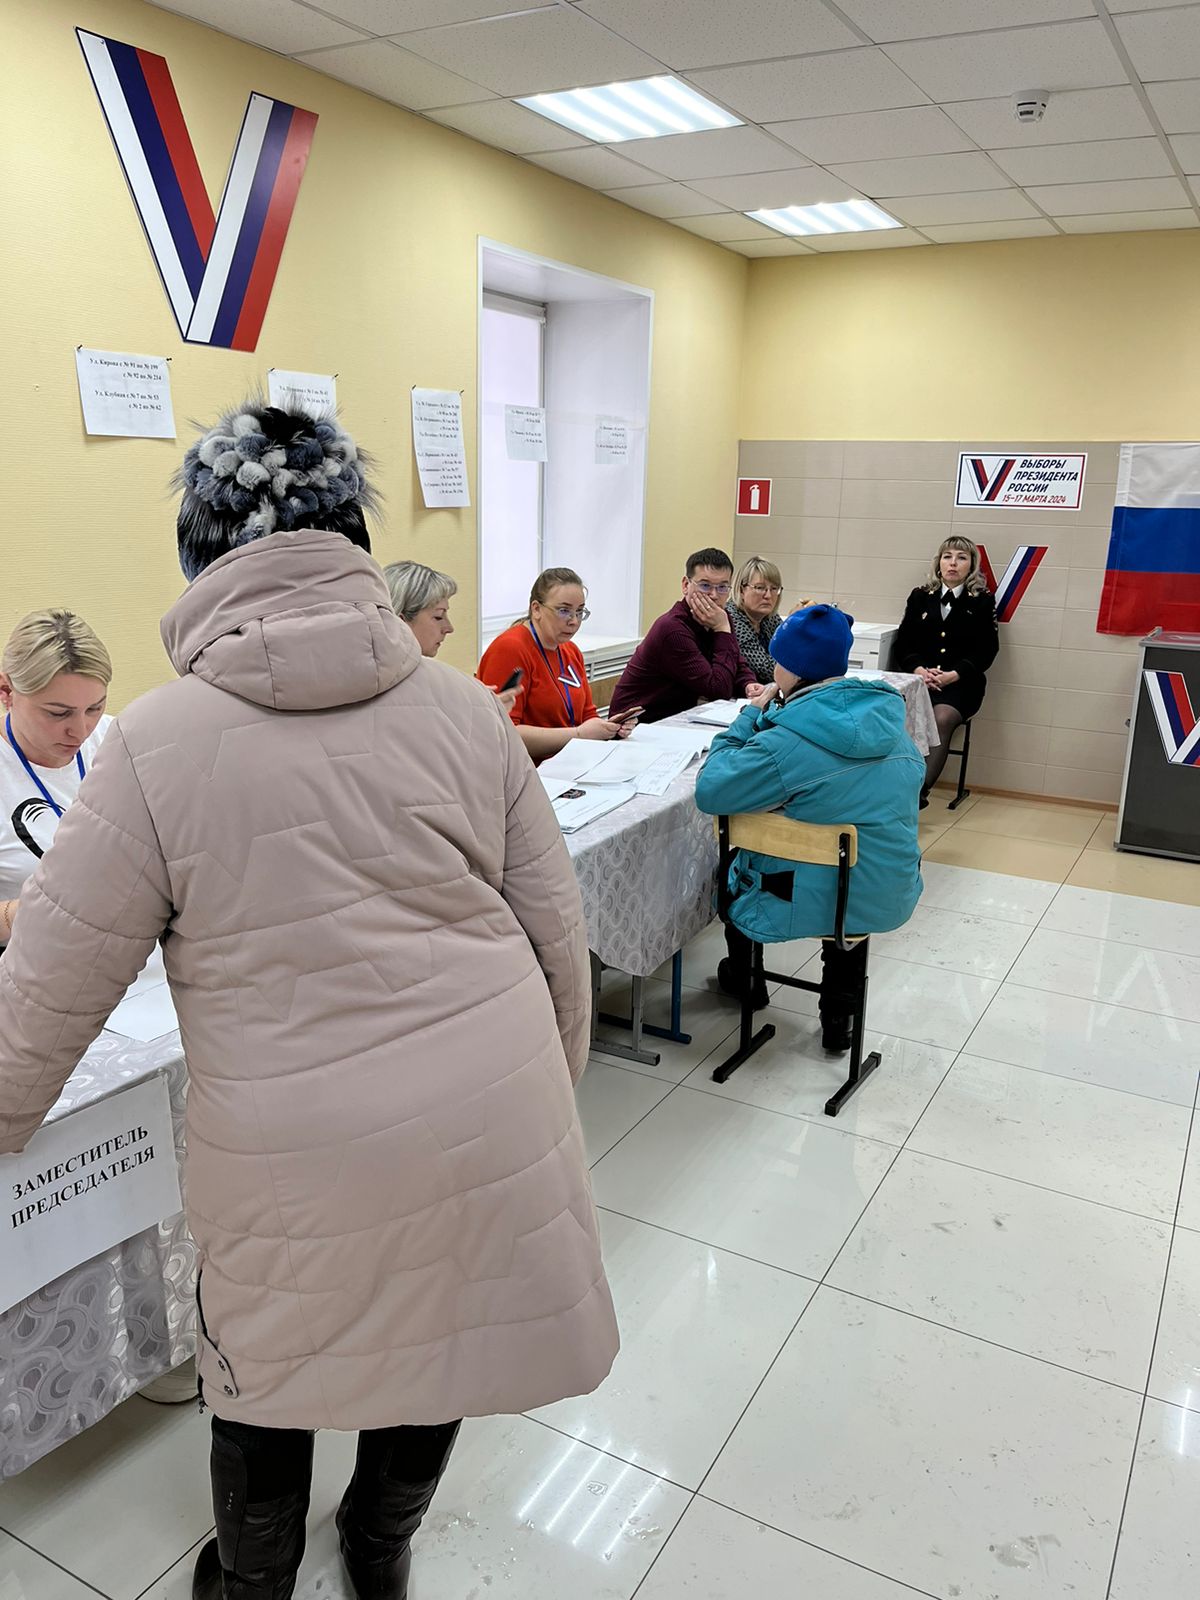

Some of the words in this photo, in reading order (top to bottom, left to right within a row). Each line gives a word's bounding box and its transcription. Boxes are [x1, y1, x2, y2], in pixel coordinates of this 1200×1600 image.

[1020, 459, 1067, 469] ВЫБОРЫ
[1013, 471, 1078, 482] ПРЕЗИДЕНТА
[1007, 483, 1049, 493] РОССИИ
[1023, 495, 1048, 503] МАРТА
[1048, 496, 1066, 504] 2024
[12, 1126, 149, 1200] ЗАМЕСТИТЕЛЬ
[11, 1146, 156, 1230] ПРЕДСЕДАТЕЛЯ
